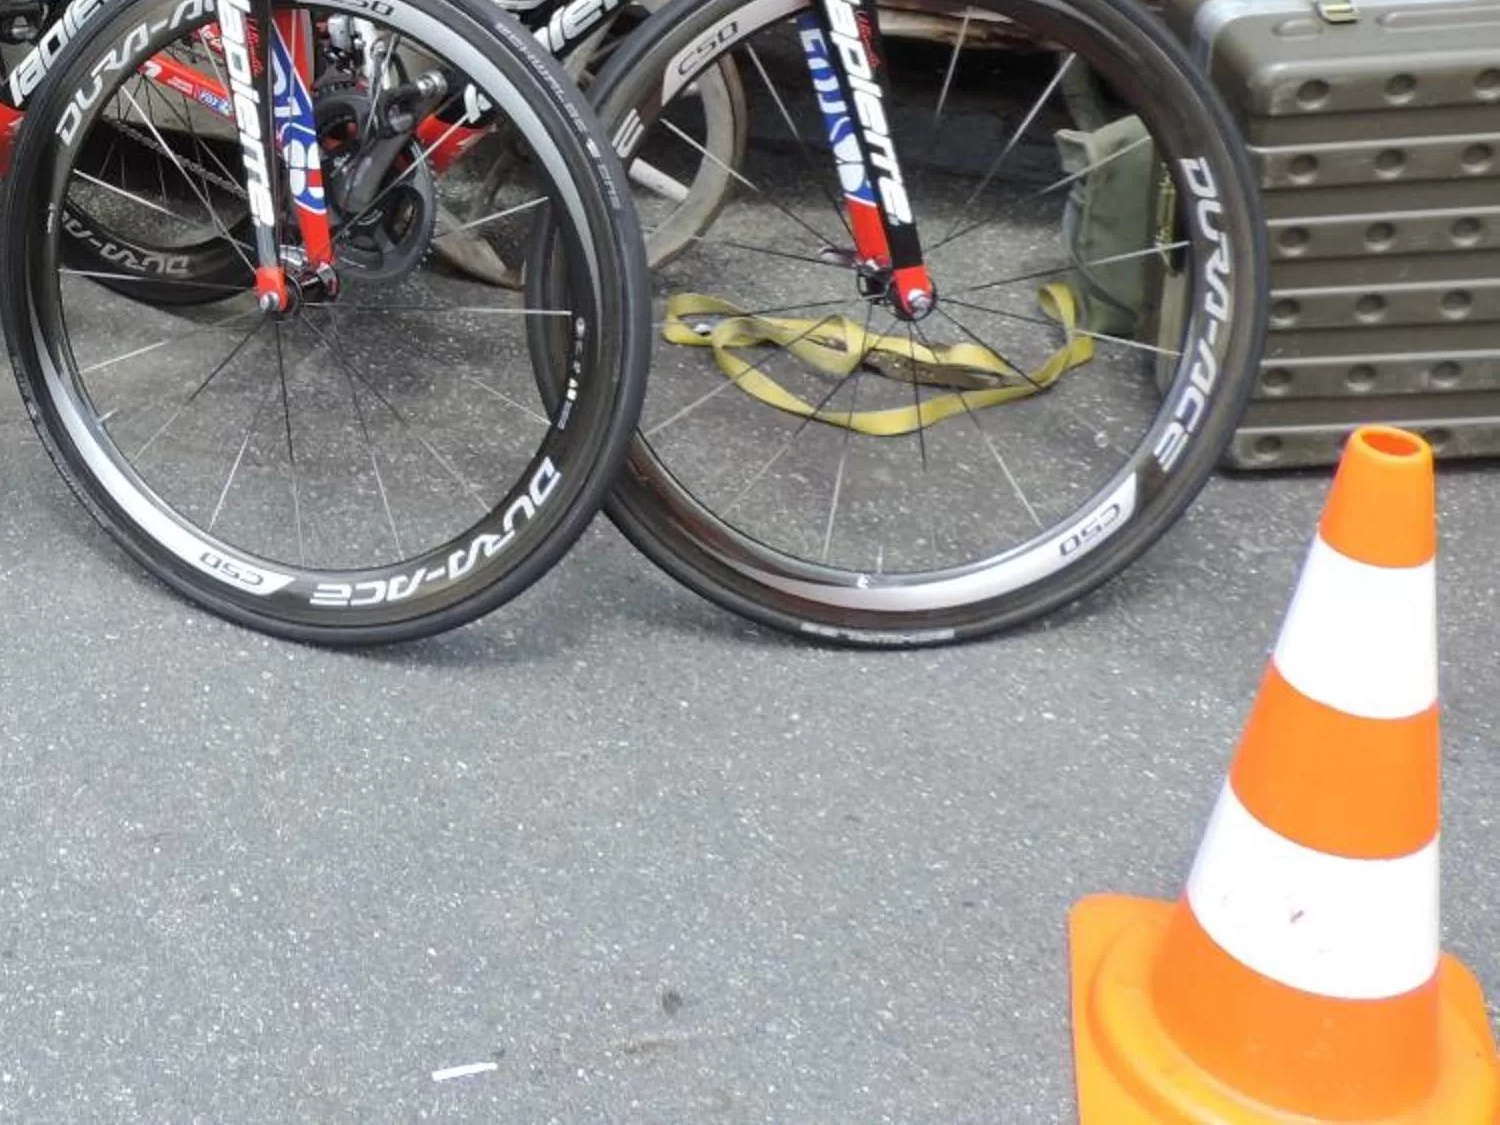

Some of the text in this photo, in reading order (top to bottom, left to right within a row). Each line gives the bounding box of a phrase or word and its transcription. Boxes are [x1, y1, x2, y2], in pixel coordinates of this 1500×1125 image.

[62, 210, 189, 274] DURA-A
[1151, 156, 1235, 473] DURA-ACE
[309, 455, 562, 607] DURA-ACE
